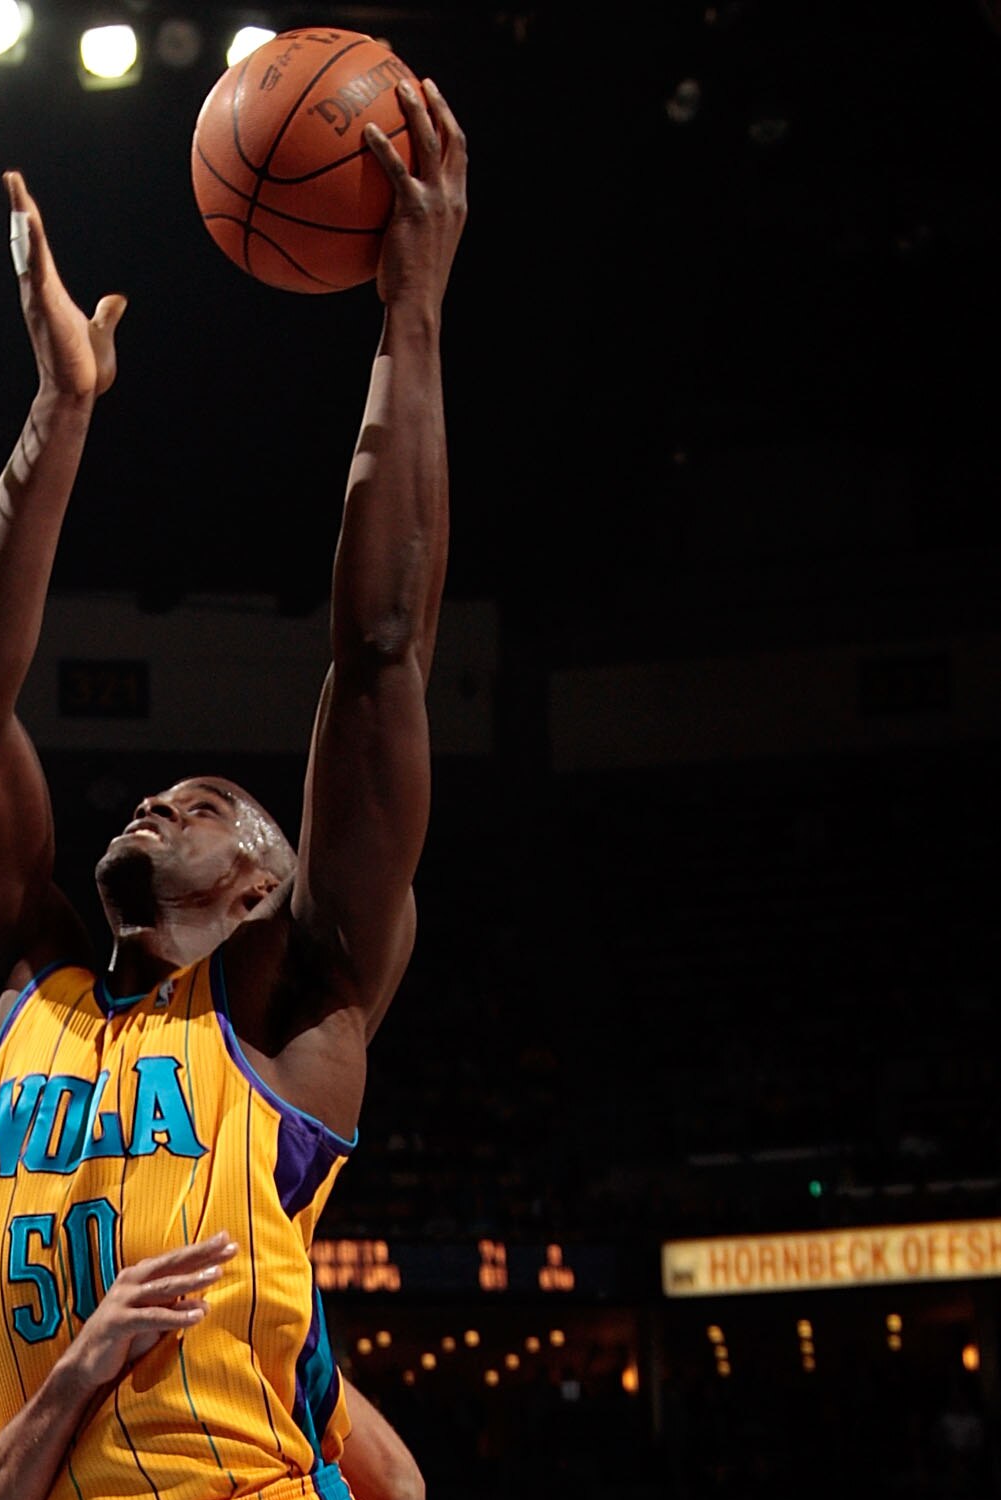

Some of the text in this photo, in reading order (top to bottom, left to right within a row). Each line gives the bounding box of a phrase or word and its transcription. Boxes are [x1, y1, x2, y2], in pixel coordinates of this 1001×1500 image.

[68, 670, 138, 705] 321
[8, 1198, 117, 1345] 50
[707, 1237, 888, 1287] HORNBECK
